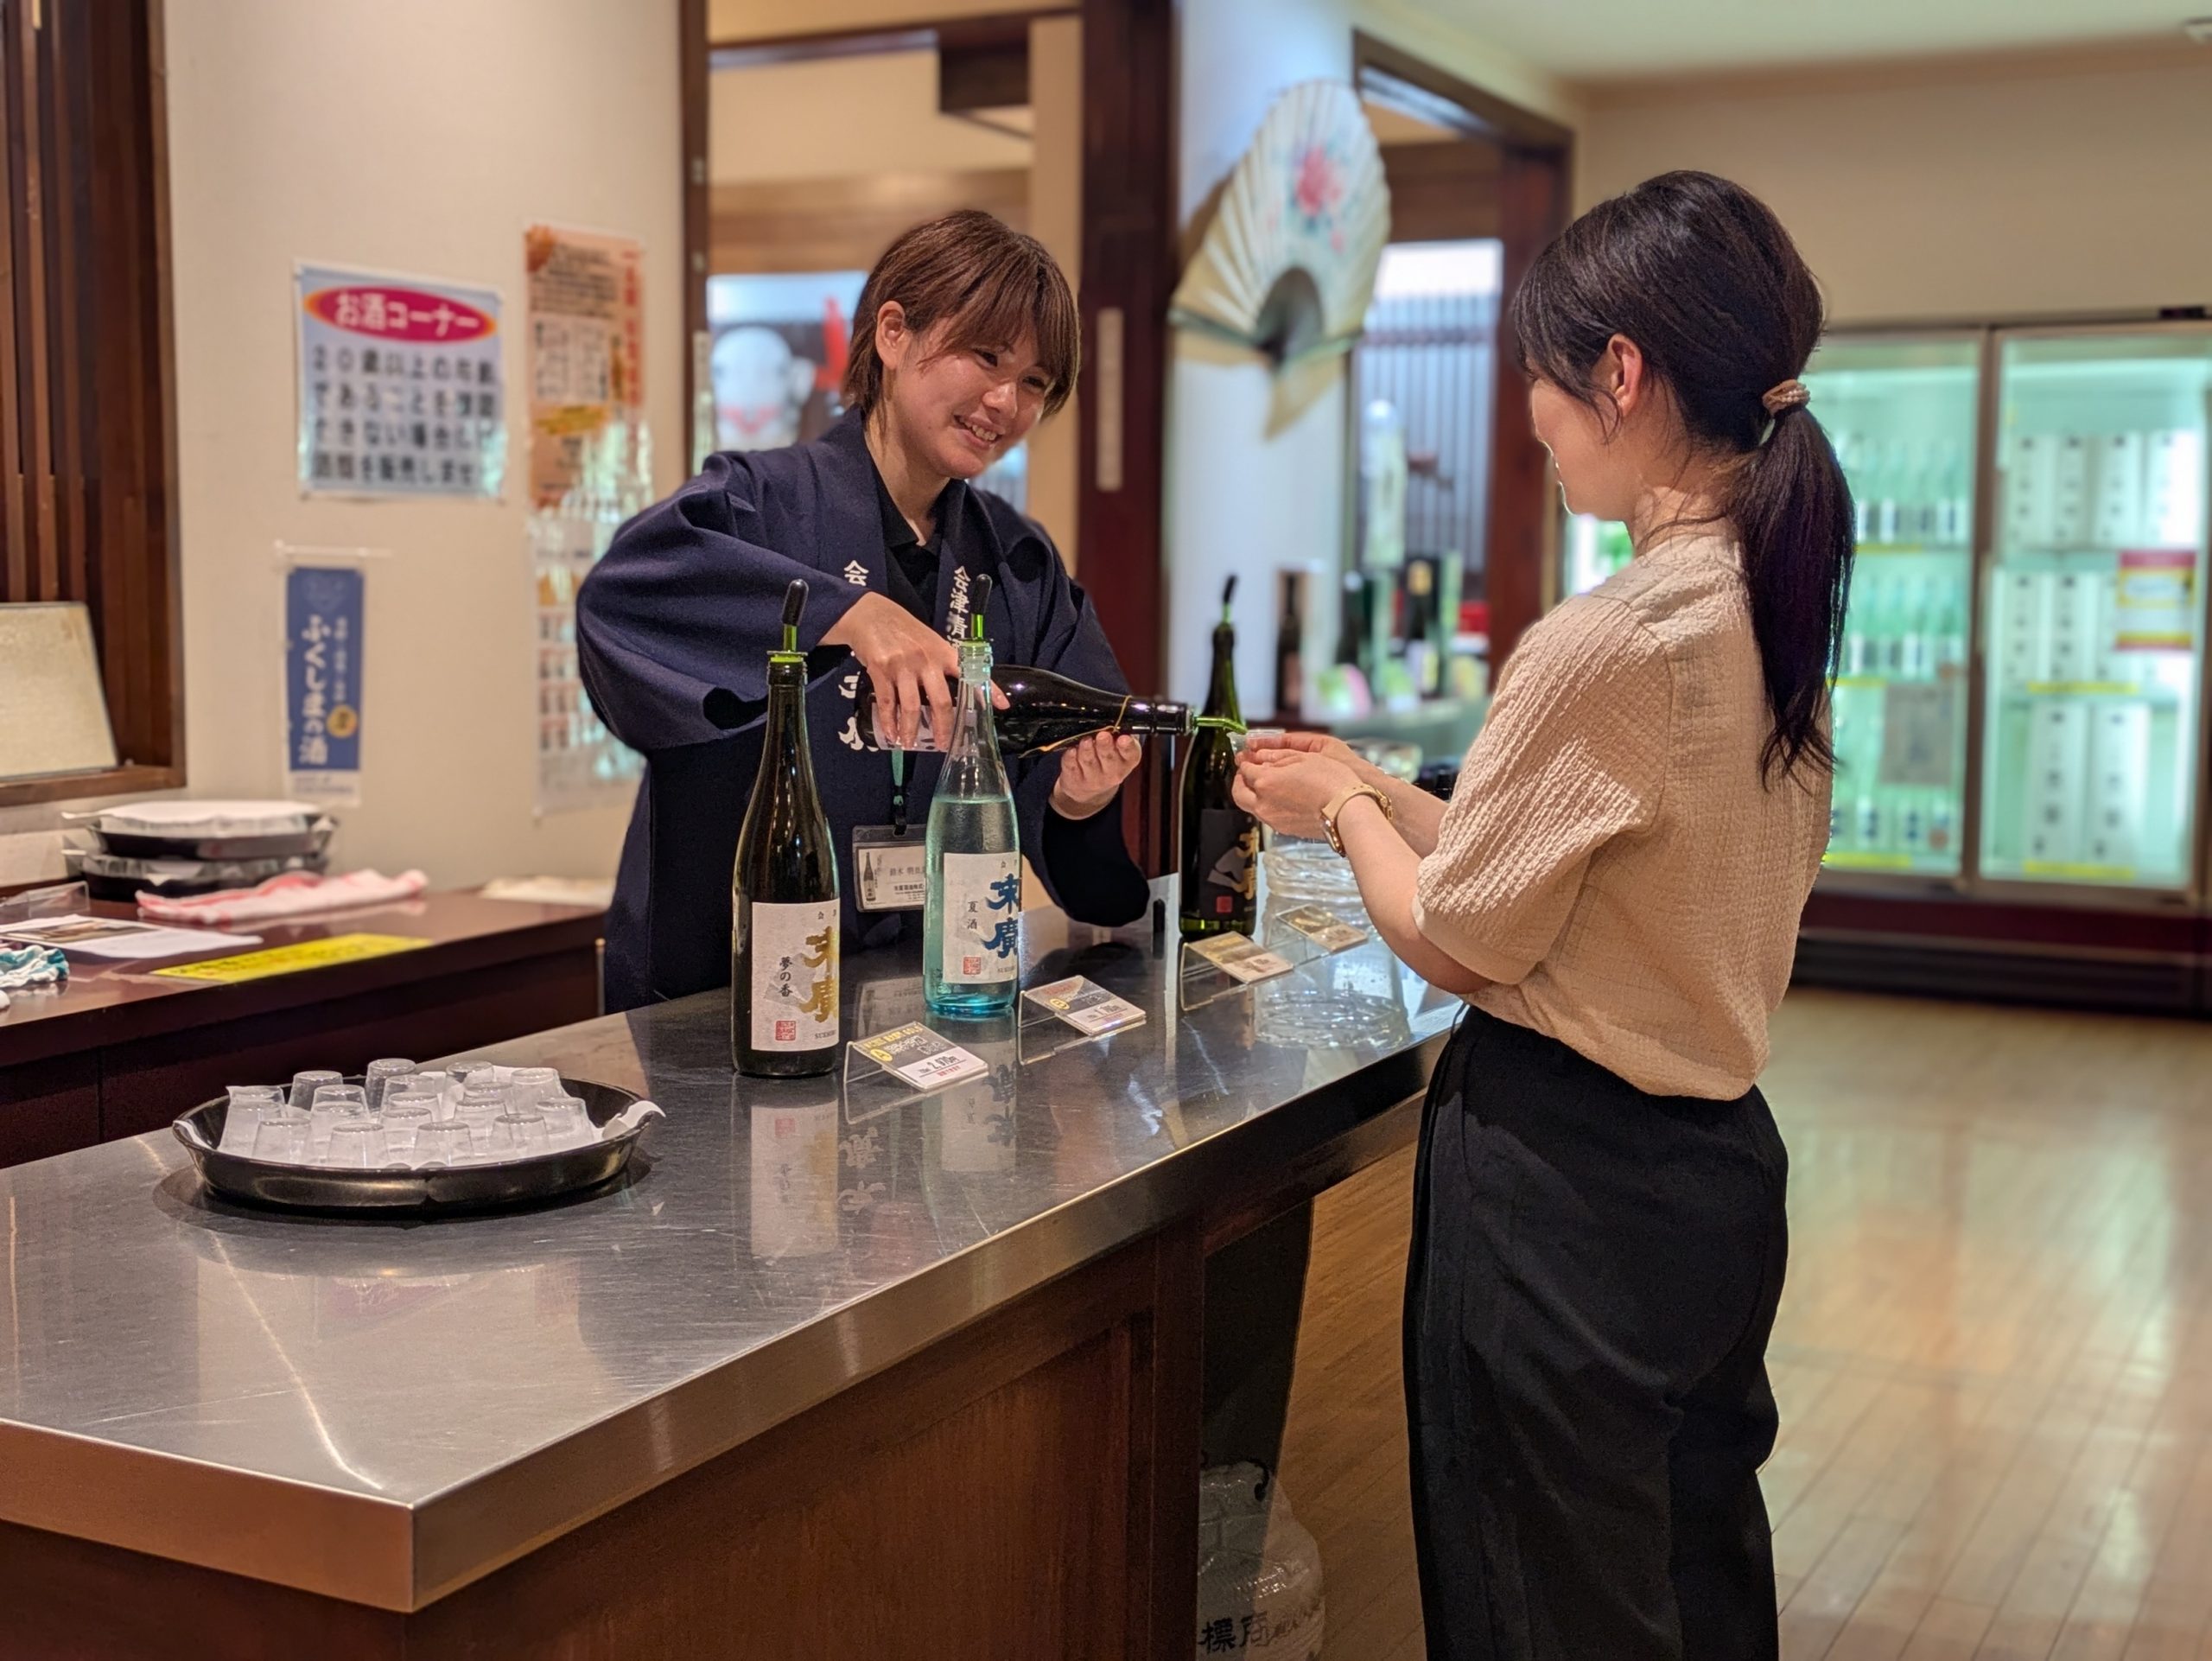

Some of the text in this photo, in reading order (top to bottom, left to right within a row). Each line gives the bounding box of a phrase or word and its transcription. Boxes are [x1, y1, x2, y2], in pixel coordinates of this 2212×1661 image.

[334, 292, 480, 338] お酒コーナー
[299, 613, 332, 765] ふくしまの酒
[967, 901, 978, 930] 夏酒
[982, 873, 1020, 958] 末廣
[779, 956, 793, 997] 夢の香
